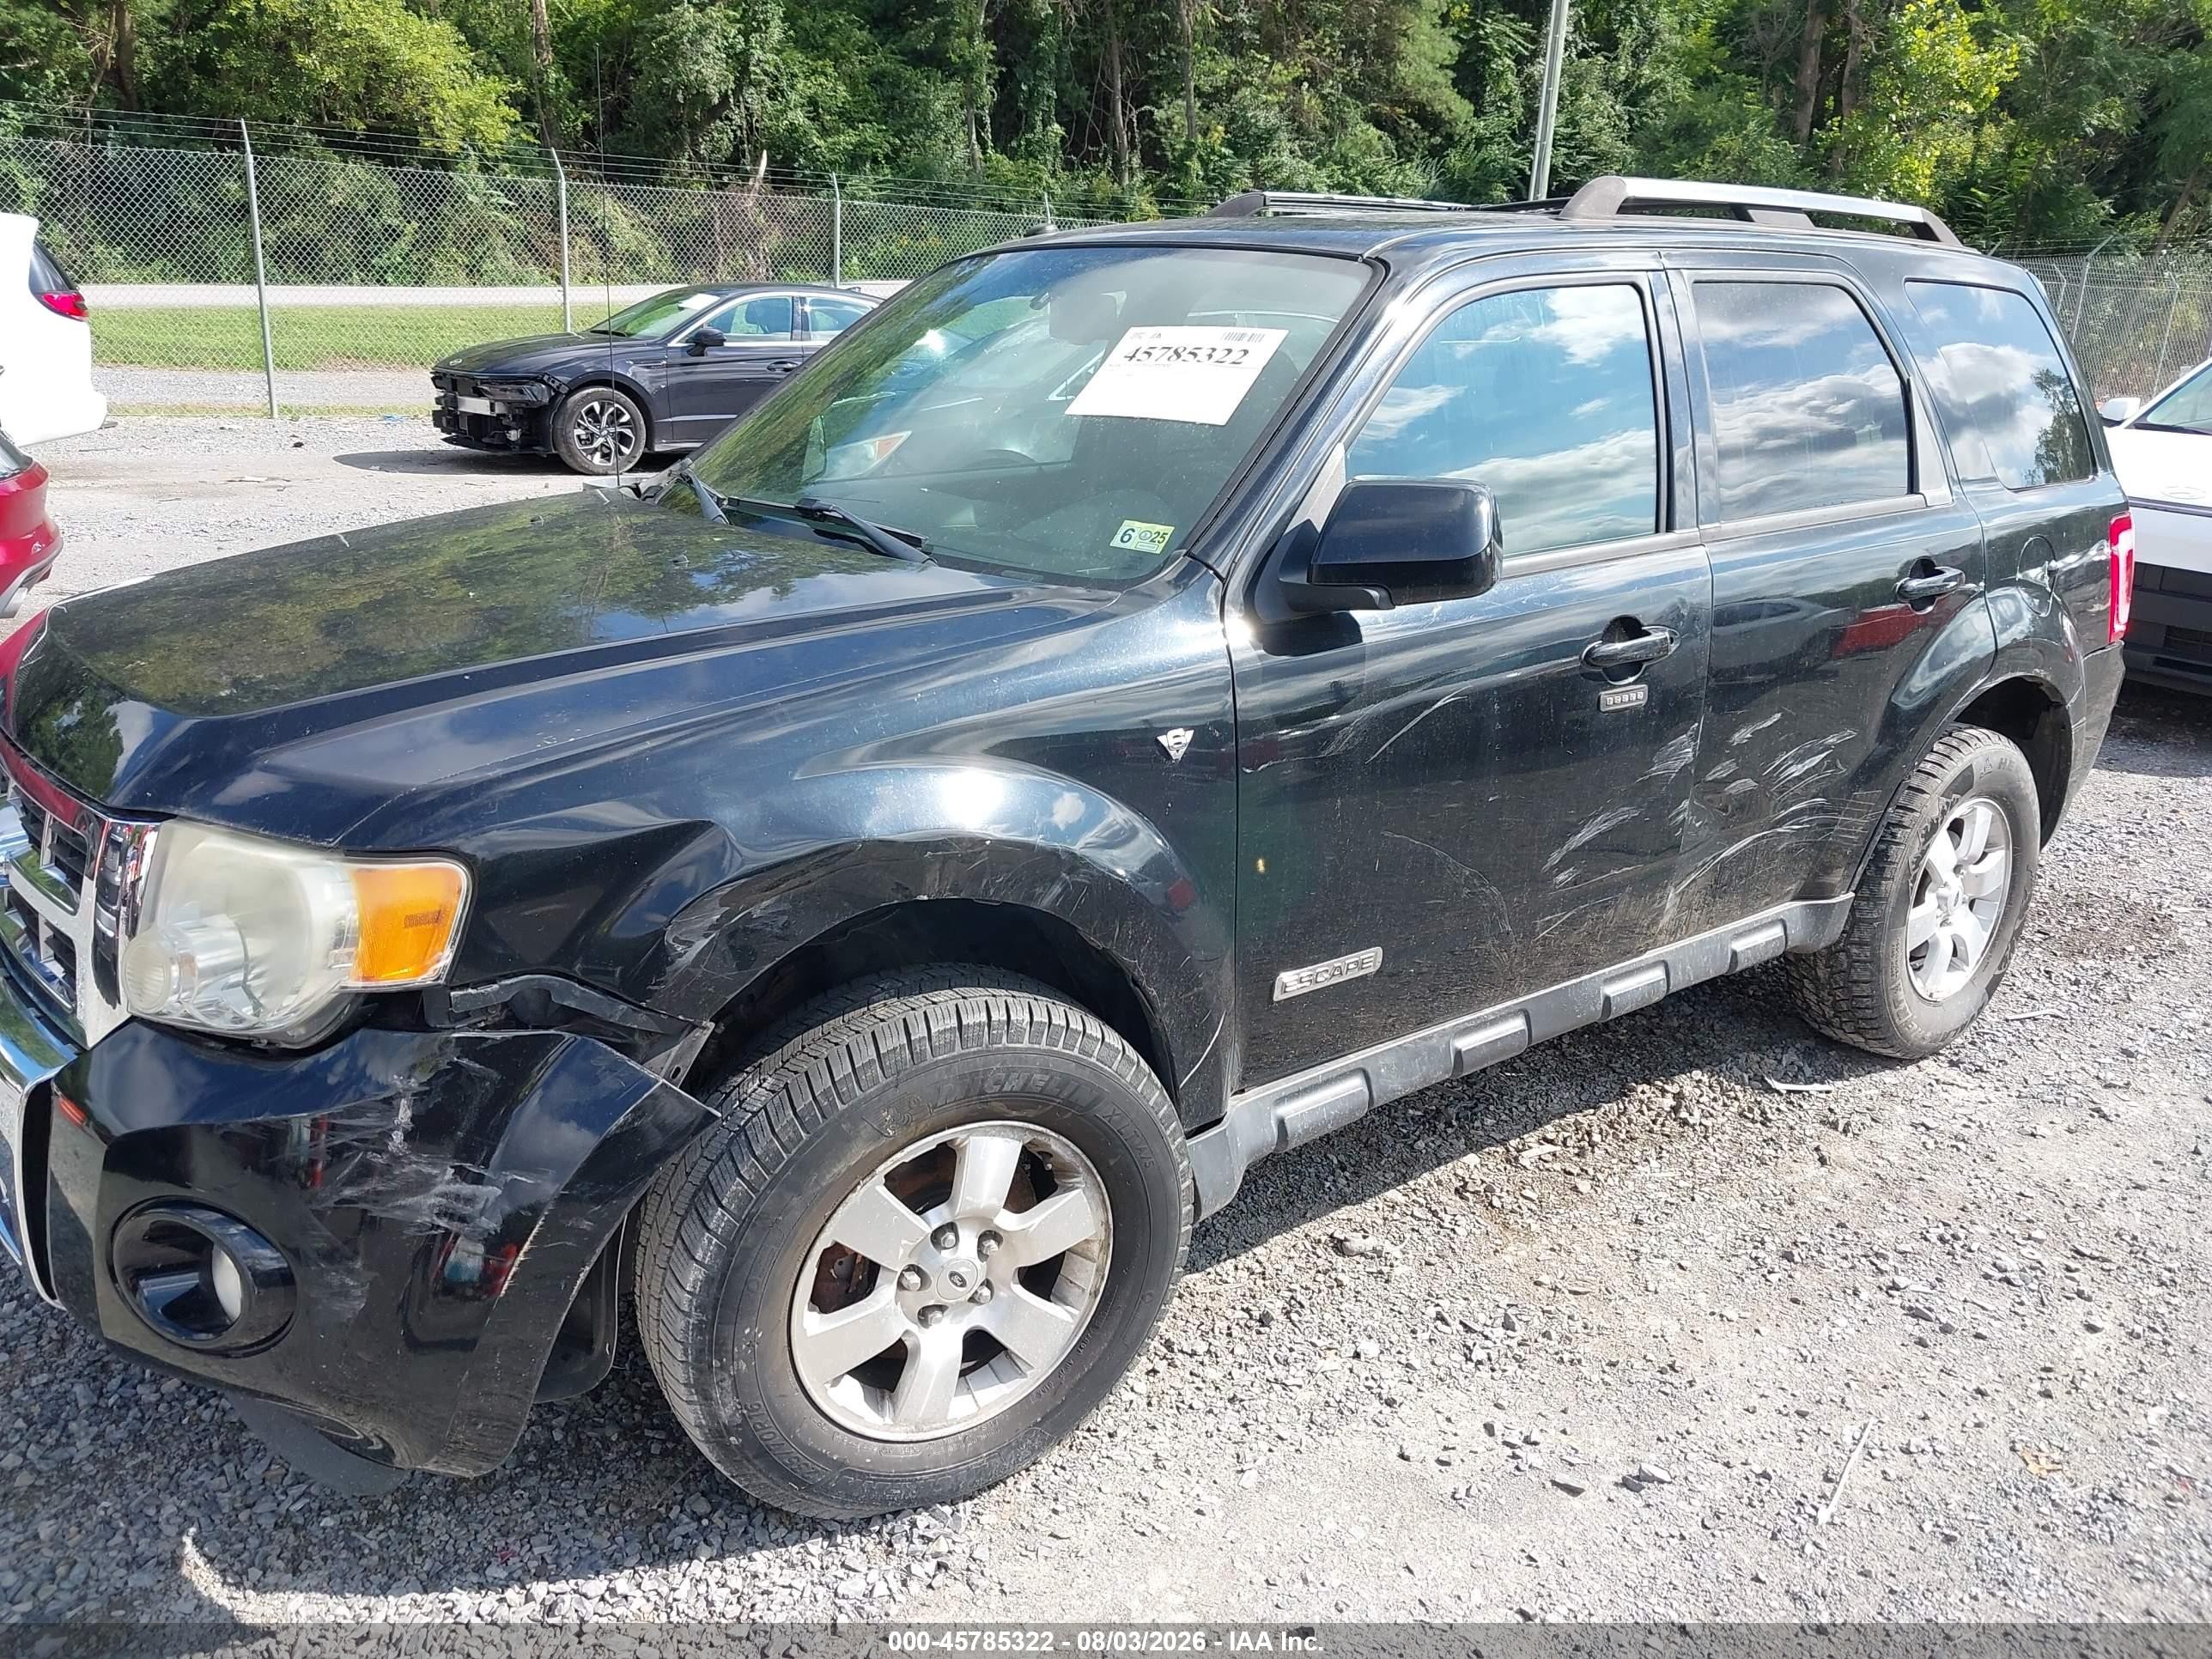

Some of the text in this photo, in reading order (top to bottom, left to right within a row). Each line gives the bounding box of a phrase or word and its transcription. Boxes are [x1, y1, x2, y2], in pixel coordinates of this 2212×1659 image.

[1123, 345, 1249, 365] 45785322
[1120, 527, 1135, 544] 6
[1149, 530, 1169, 544] 25
[1280, 951, 1376, 995] ESCAPE
[935, 1071, 1104, 1113] MICHELIN
